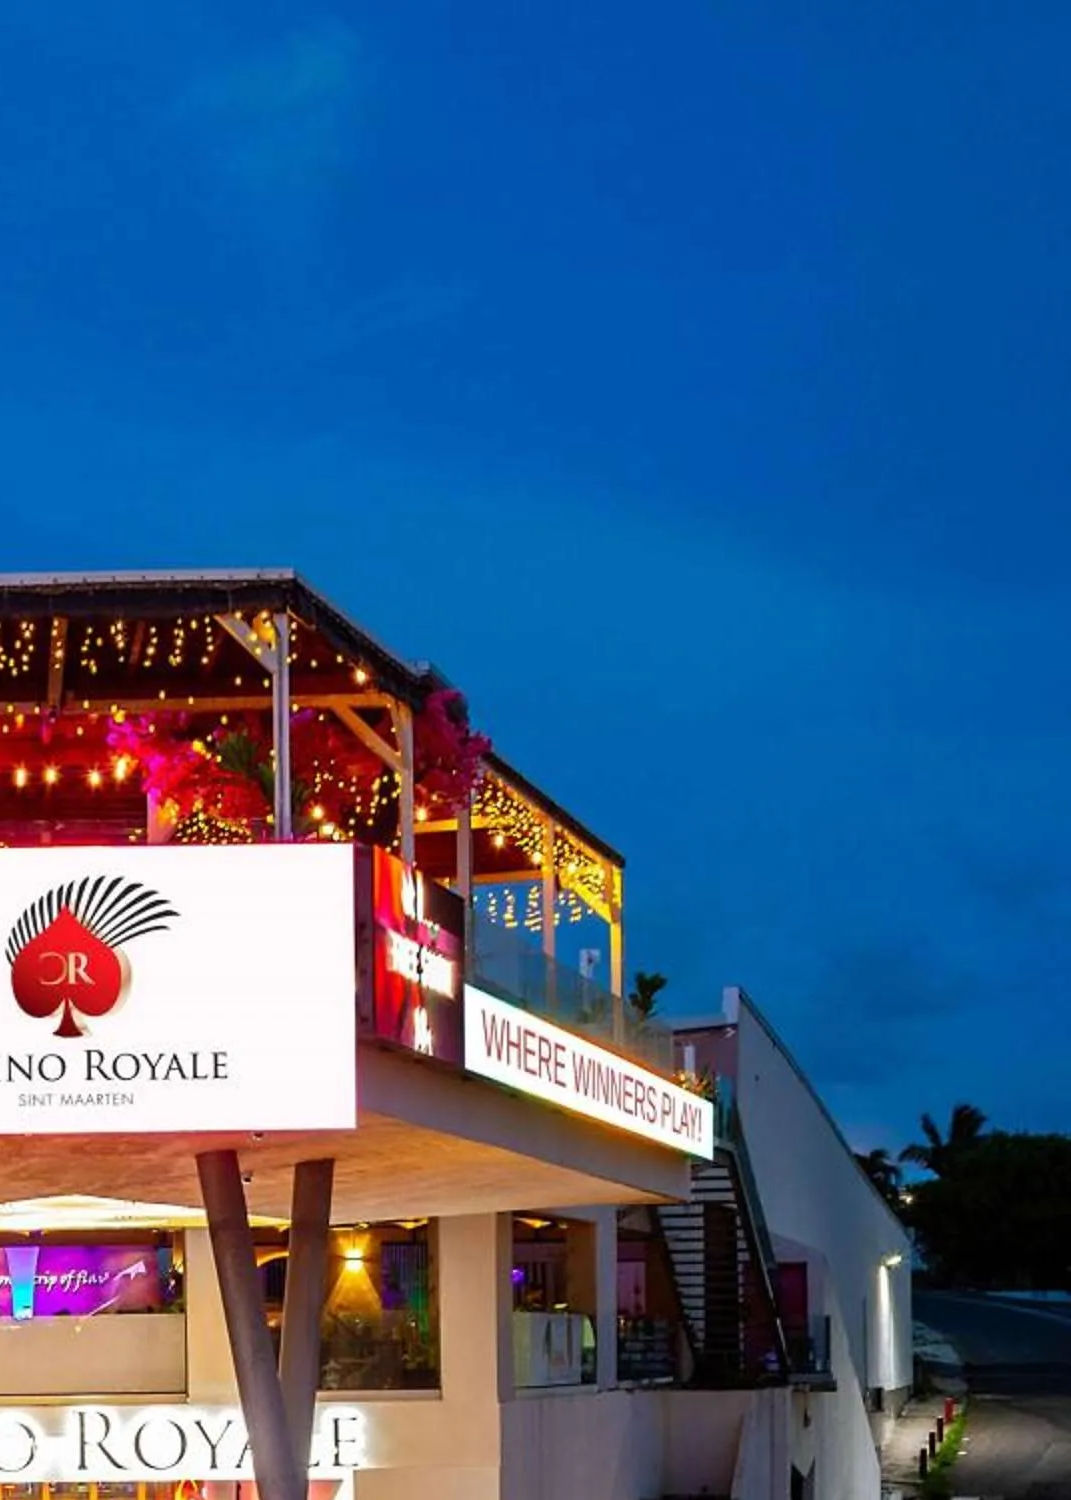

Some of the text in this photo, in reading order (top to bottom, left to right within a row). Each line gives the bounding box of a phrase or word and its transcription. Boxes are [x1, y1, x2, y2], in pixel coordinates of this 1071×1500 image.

[84, 1049, 229, 1082] ROYALE
[481, 1009, 567, 1087] WHERE
[571, 1051, 658, 1124] WINNERS
[660, 1091, 702, 1142] PLAY!
[18, 1092, 135, 1108] SINT MAARTEN
[75, 1410, 359, 1471] ROYE
